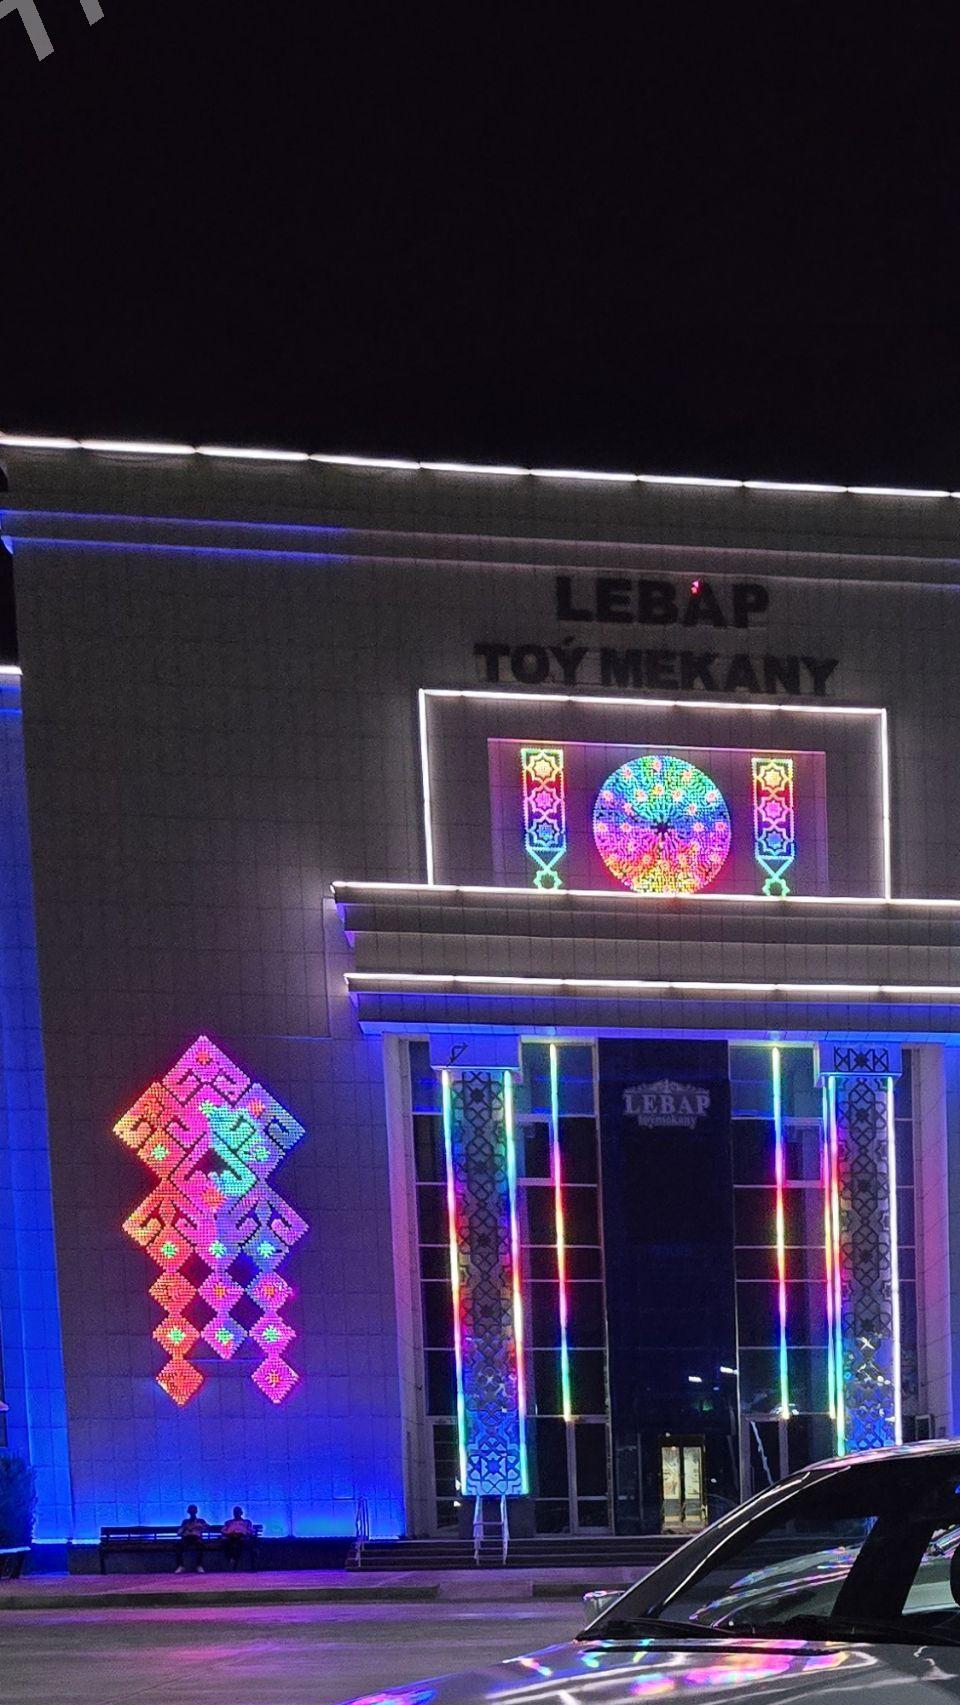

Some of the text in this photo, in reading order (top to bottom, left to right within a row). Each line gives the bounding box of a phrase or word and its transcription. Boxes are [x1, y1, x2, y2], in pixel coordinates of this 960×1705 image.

[555, 575, 770, 629] LEBAP
[473, 636, 839, 697] TOÝ MEKANY
[623, 1094, 711, 1116] LEBAP
